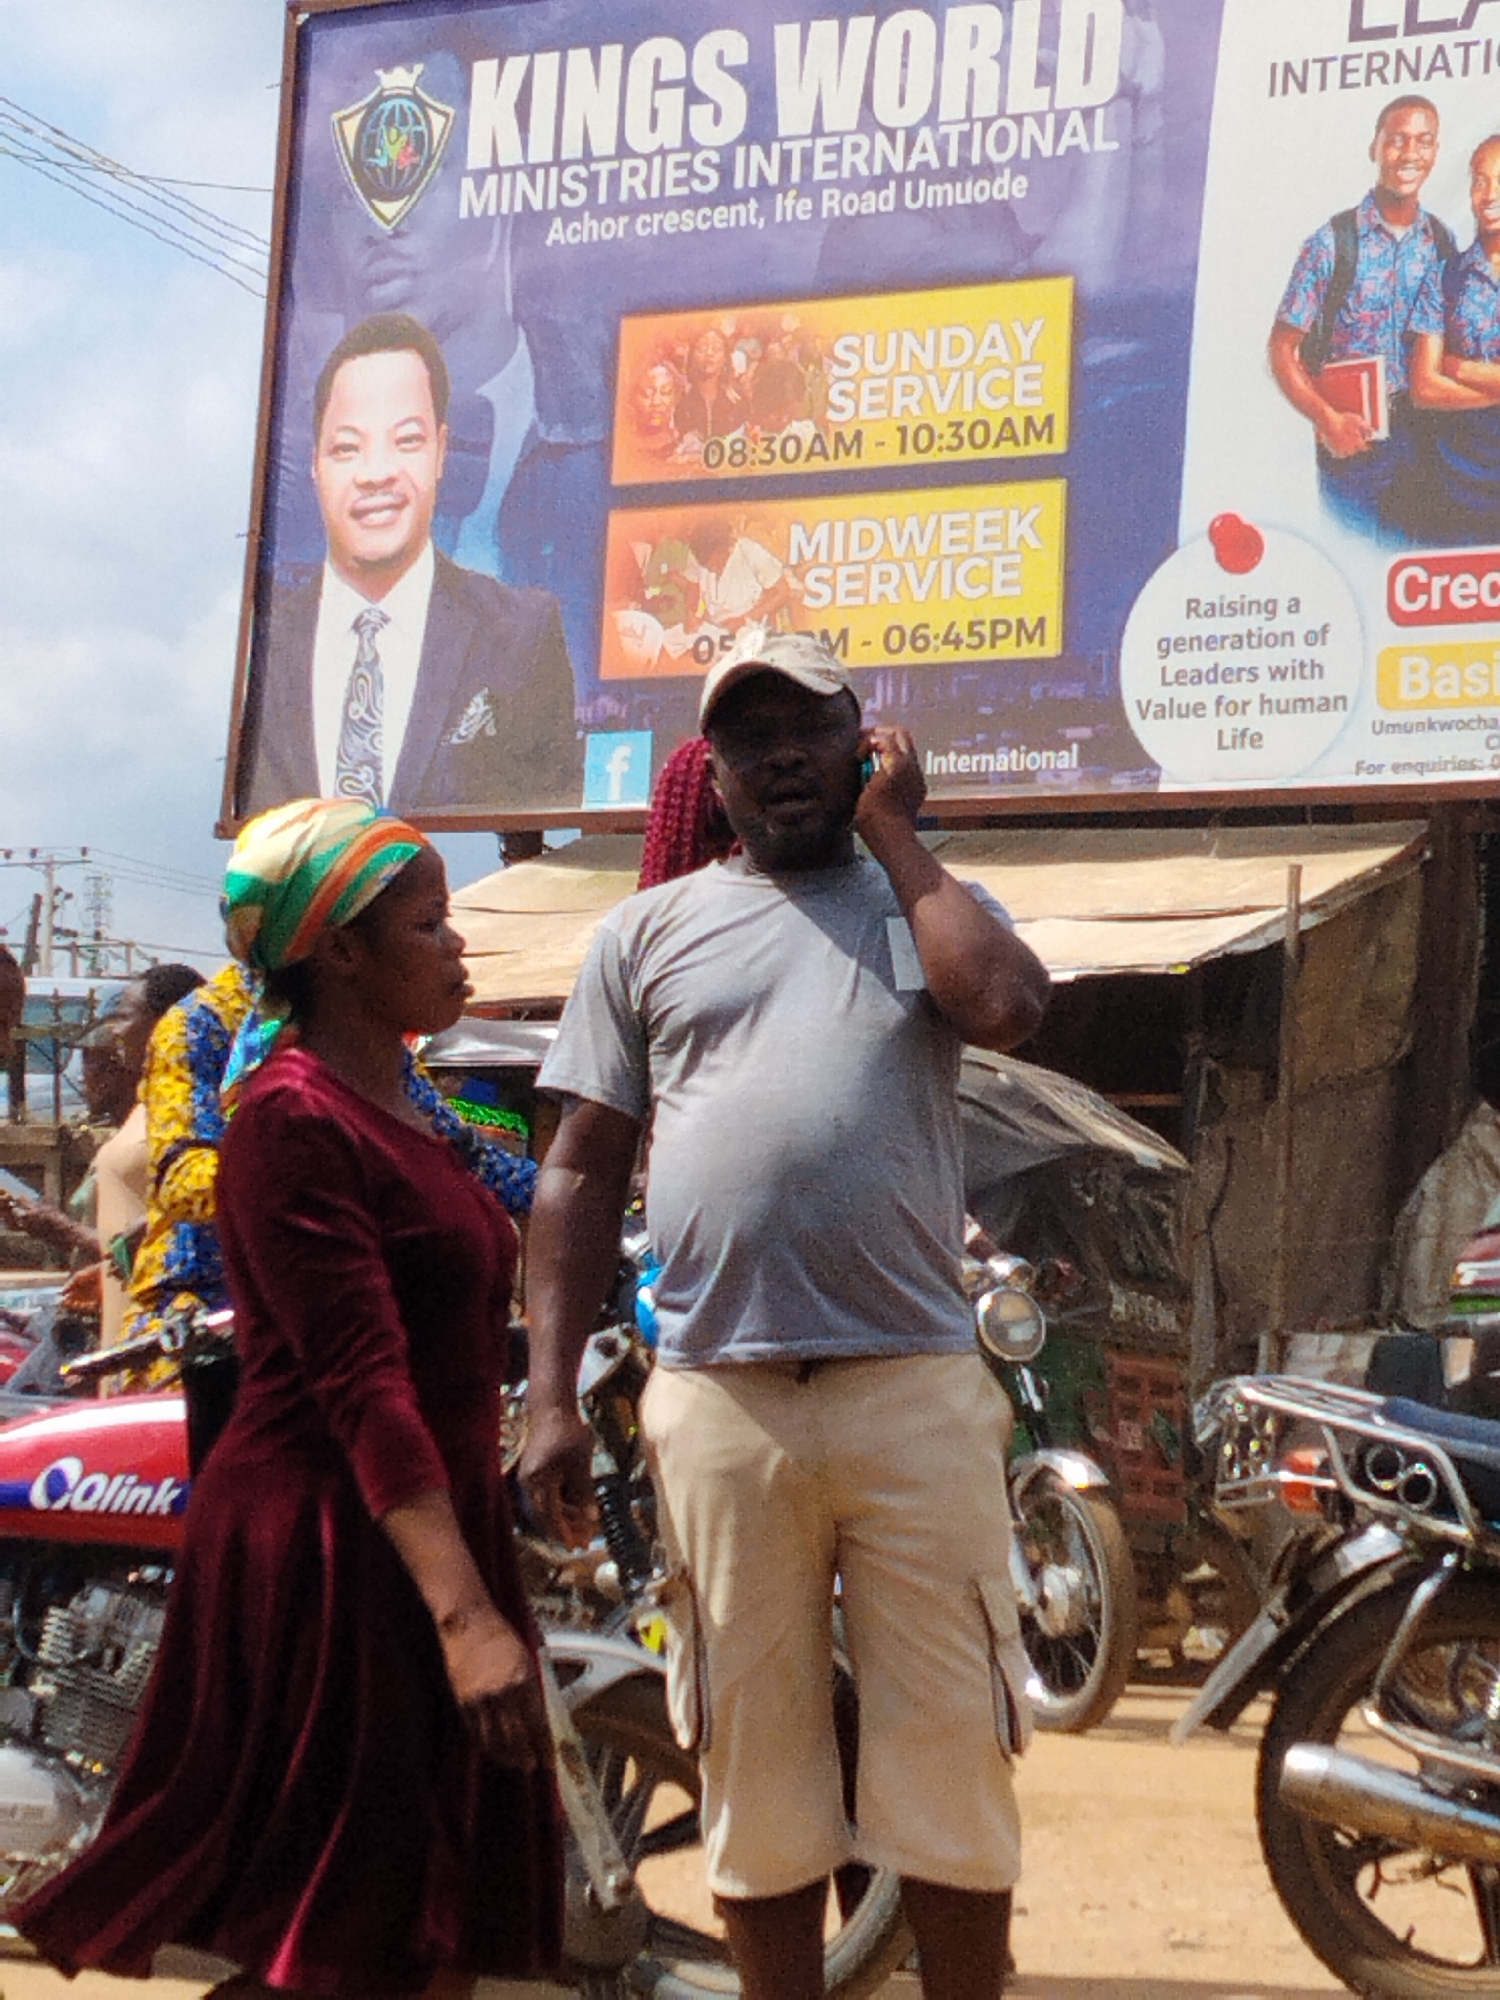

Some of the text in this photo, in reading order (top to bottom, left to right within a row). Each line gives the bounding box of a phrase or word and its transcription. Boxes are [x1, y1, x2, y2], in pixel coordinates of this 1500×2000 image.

[465, 0, 1124, 170] KINGS WORLD
[1269, 38, 1500, 97] INTERNATI
[459, 106, 1120, 219] MINISTRIES INTERNATIONAL
[546, 168, 1029, 247] Achor crescent, Ife Road Umuode
[831, 317, 1046, 377] SUNDAY
[826, 363, 1044, 423] SERVICE
[702, 429, 863, 470] 08:30AM
[898, 413, 1056, 456] 10:30AM
[788, 507, 1043, 565] MIDWEEK
[802, 554, 1023, 610] SERVICE
[1185, 596, 1301, 620] Raising a
[883, 616, 1047, 655] 06:45PM
[1157, 623, 1331, 660] generation of
[1160, 658, 1325, 687] Leaders with
[1136, 692, 1349, 720] Value for human
[924, 742, 1079, 775] International
[1216, 727, 1264, 751] Life
[1354, 760, 1386, 777] For
